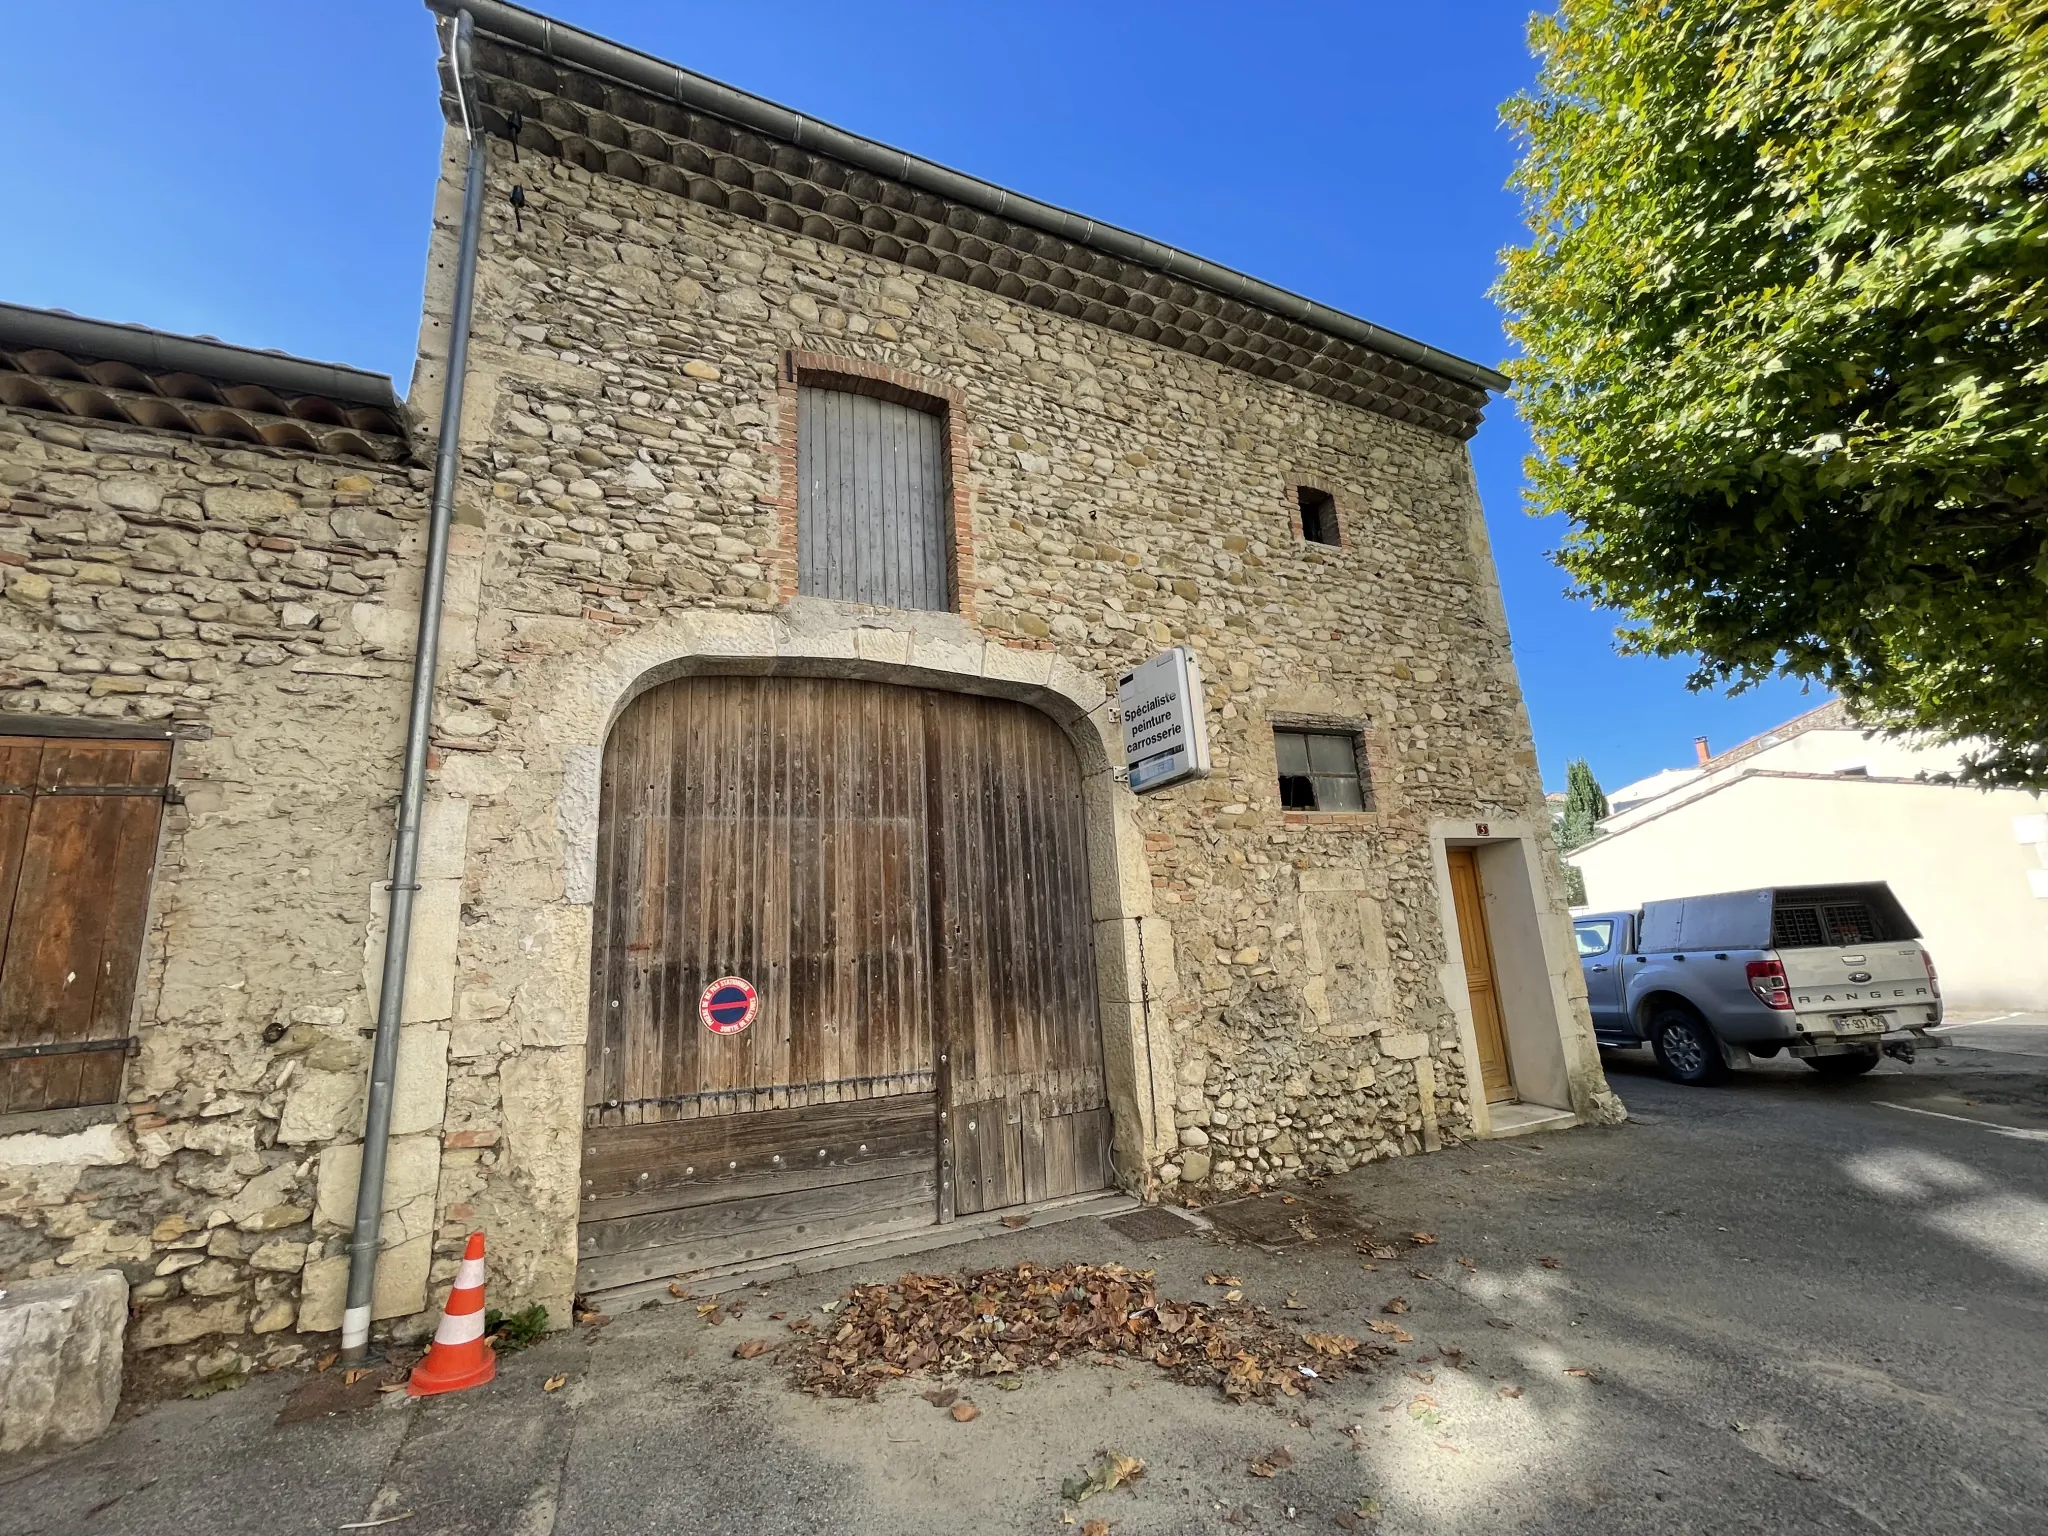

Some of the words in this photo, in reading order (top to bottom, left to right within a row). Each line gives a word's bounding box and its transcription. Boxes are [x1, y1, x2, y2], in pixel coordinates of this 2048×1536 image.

[1124, 692, 1176, 722] Spécialiste
[1127, 724, 1181, 753] carrosserie
[1132, 711, 1171, 738] peinture
[1798, 988, 1928, 1004] RANGER
